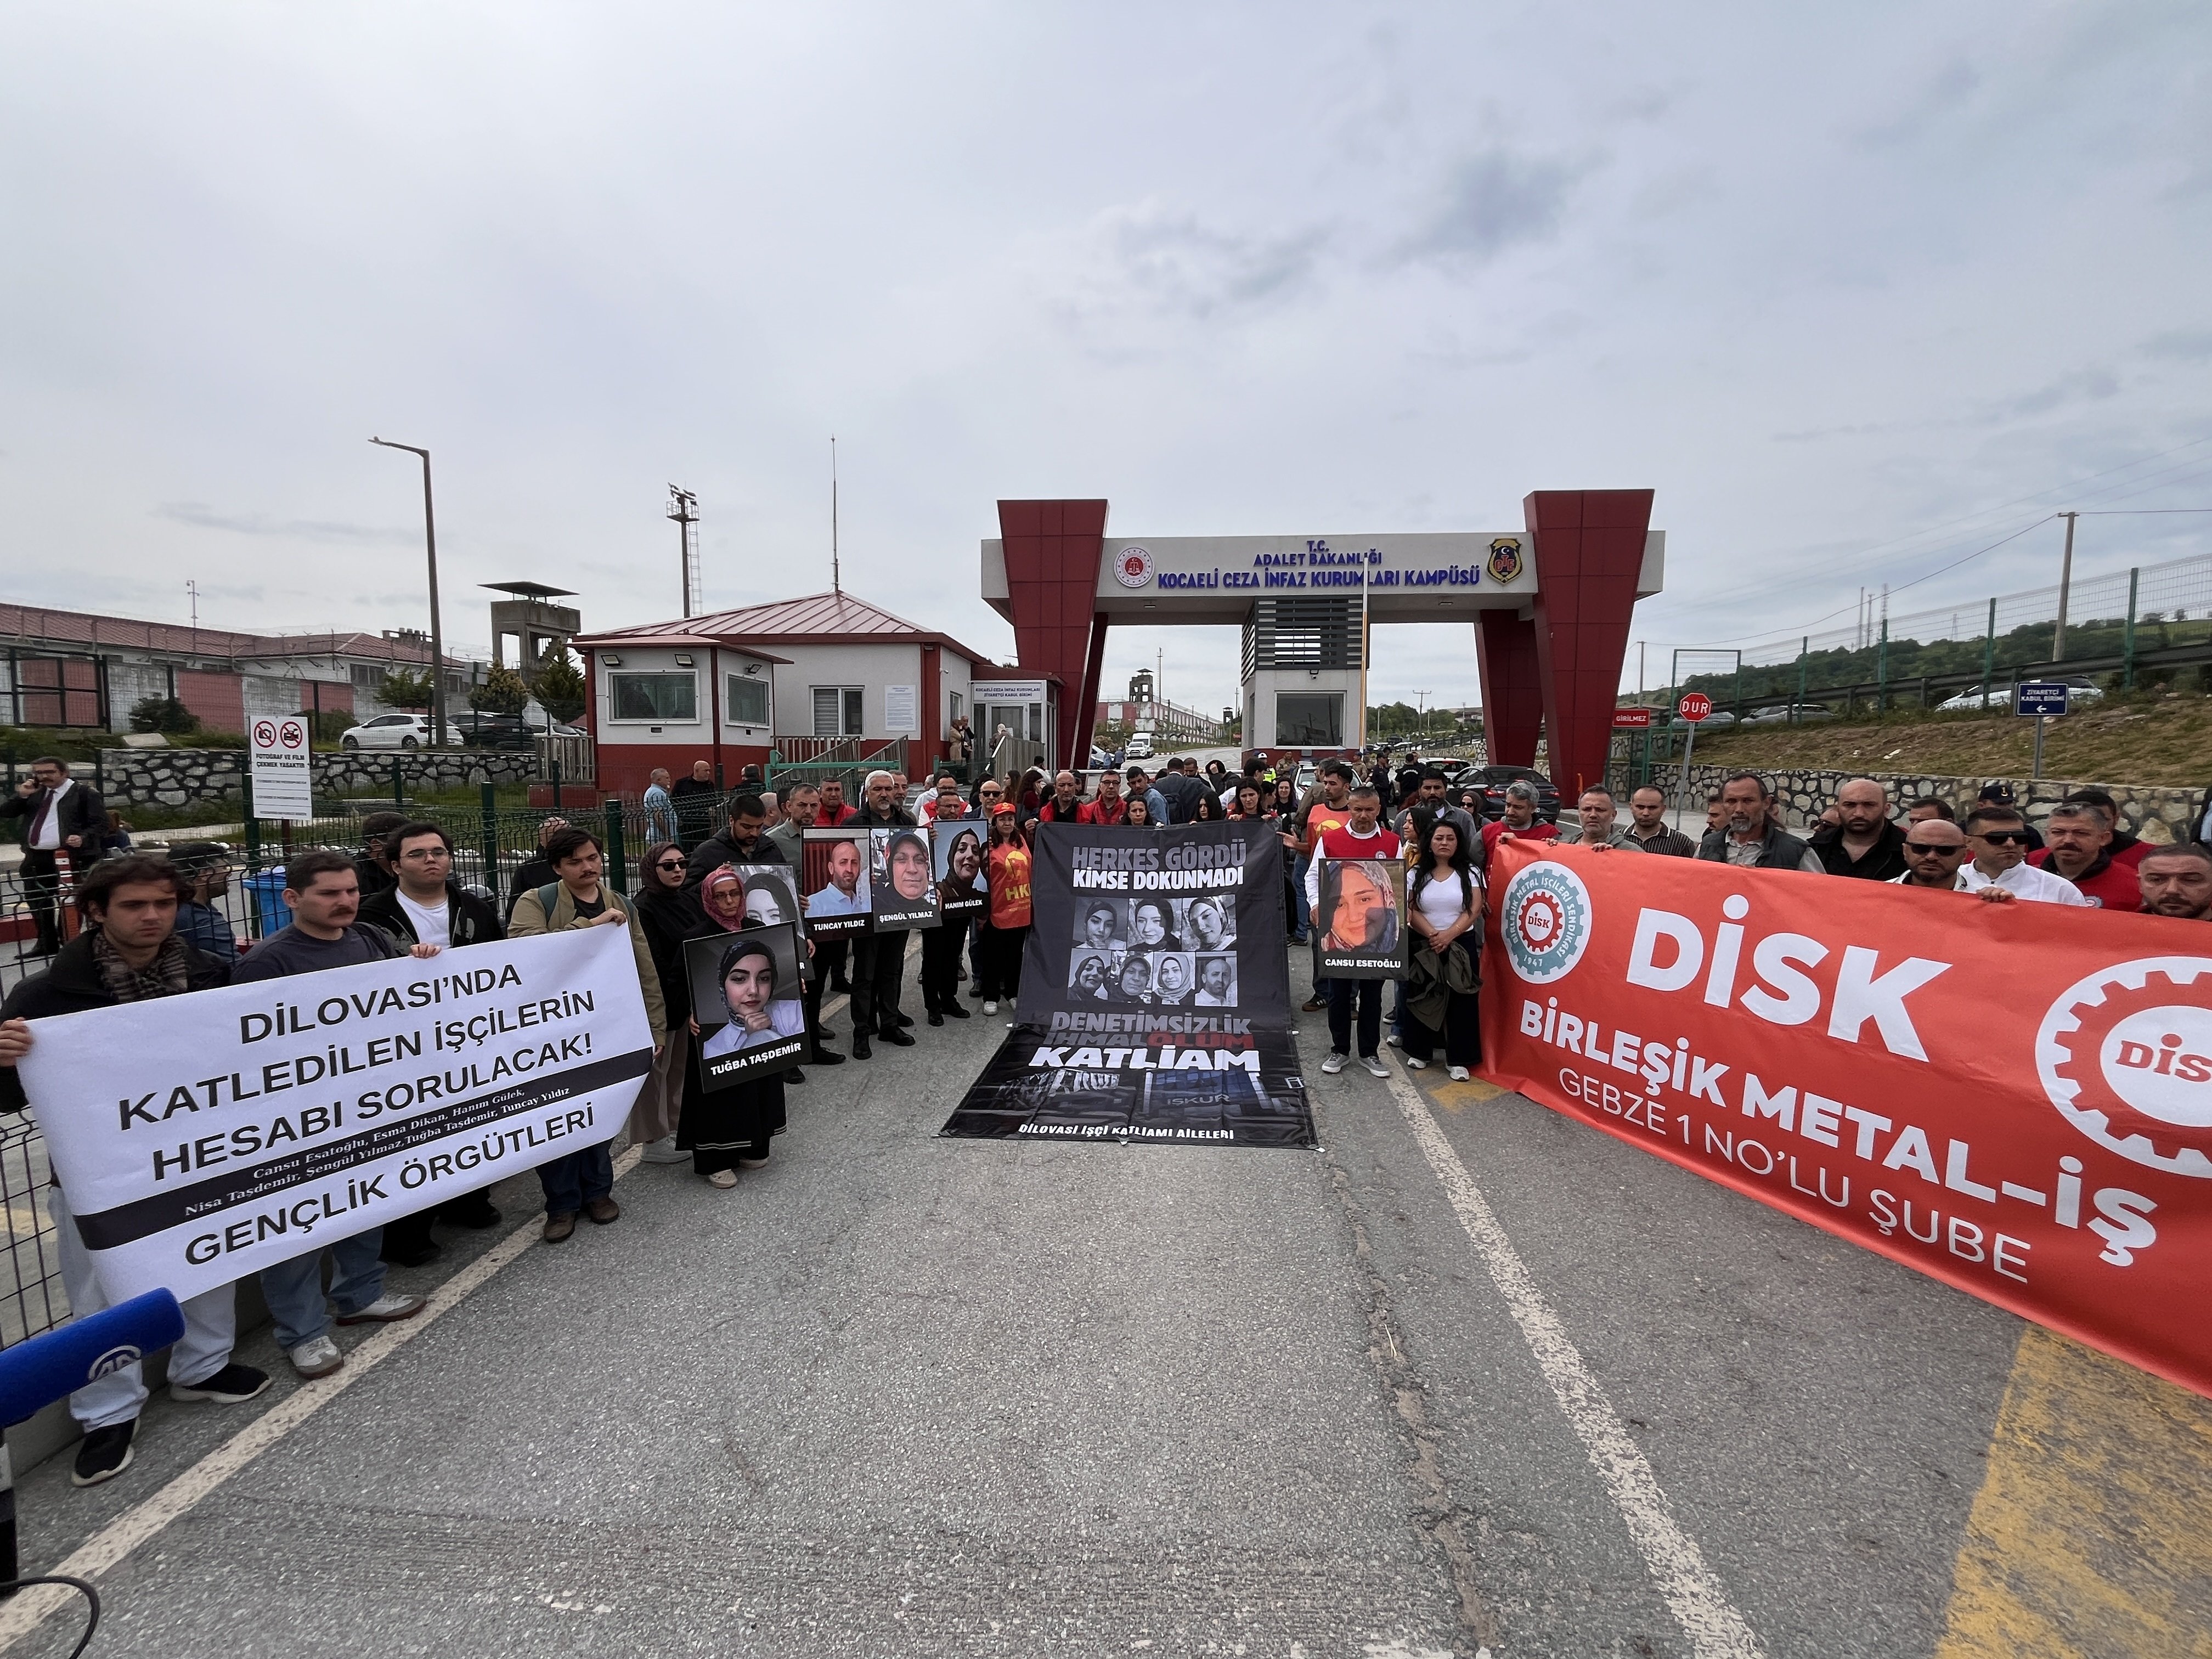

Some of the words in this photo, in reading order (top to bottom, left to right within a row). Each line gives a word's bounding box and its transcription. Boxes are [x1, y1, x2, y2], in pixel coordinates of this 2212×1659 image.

[1307, 540, 1329, 552] T.C.
[1254, 554, 1306, 567] ADALET
[1158, 568, 1218, 589] KOCAELİ
[1223, 572, 1260, 588] CEZA
[1264, 567, 1306, 587] İNFAZ
[1311, 571, 1400, 587] KURUMLARI
[1404, 565, 1480, 586] KAMPÜSÜ
[1682, 701, 1708, 714] DUR
[1072, 847, 1159, 871] HERKES
[1165, 838, 1246, 871] GÖRDÜ
[1073, 866, 1128, 890] KİMSE
[1133, 866, 1244, 890] DOKUNMADI
[1516, 877, 1539, 899] METAL
[1006, 883, 1031, 901] HK
[879, 912, 907, 923] ŞENGÜL
[907, 911, 933, 919] YILMAZ
[945, 901, 964, 910] HANIM
[814, 922, 842, 931] TUNCAY
[843, 919, 865, 928] YILDIZ
[1528, 912, 1550, 929] DİSK
[1325, 958, 1355, 967] CANSU
[1356, 958, 1401, 968] ESETOĞLU
[1523, 955, 1543, 967] 1947
[1626, 894, 1953, 1063] DİSK
[240, 964, 522, 1044] DİLOVASI'NDA
[1051, 1009, 1252, 1035] DENETİMSİZLİK
[119, 1031, 421, 1131] KATLEDİLEN
[436, 990, 595, 1053] İŞÇİLERİN
[710, 1058, 748, 1075] TUĞBA
[749, 1042, 802, 1063] TAŞDEMİR
[1028, 1045, 1261, 1072] KATLİAM
[1519, 996, 1730, 1108] BİRLEŞİK
[153, 1101, 342, 1181] HESABI
[357, 1032, 592, 1120] SORULACAK!
[253, 1159, 300, 1180] Cansu
[305, 1136, 369, 1164] Esatoğlu,
[373, 1125, 406, 1142] Esma
[410, 1114, 448, 1131] Dikan,
[452, 1099, 489, 1117] Hanım
[492, 1088, 526, 1105] Gülek,
[1018, 1123, 1079, 1135] DİLOVASI
[185, 1198, 222, 1216] Nisa
[227, 1172, 301, 1203] Taşdemir,
[306, 1154, 354, 1178] Şengül
[444, 1109, 498, 1132] Taşdemir,
[500, 1097, 539, 1114] Tuncay
[541, 1087, 570, 1102] Yıldız
[185, 1173, 388, 1266] GENÇLİK
[399, 1102, 594, 1189] ÖRGÜTLERİ
[1559, 1068, 1667, 1136] GEBZE
[1677, 1114, 1690, 1145] 1
[1705, 1122, 1849, 1207] NO'LU
[1869, 1188, 2030, 1284] ŞUBE
